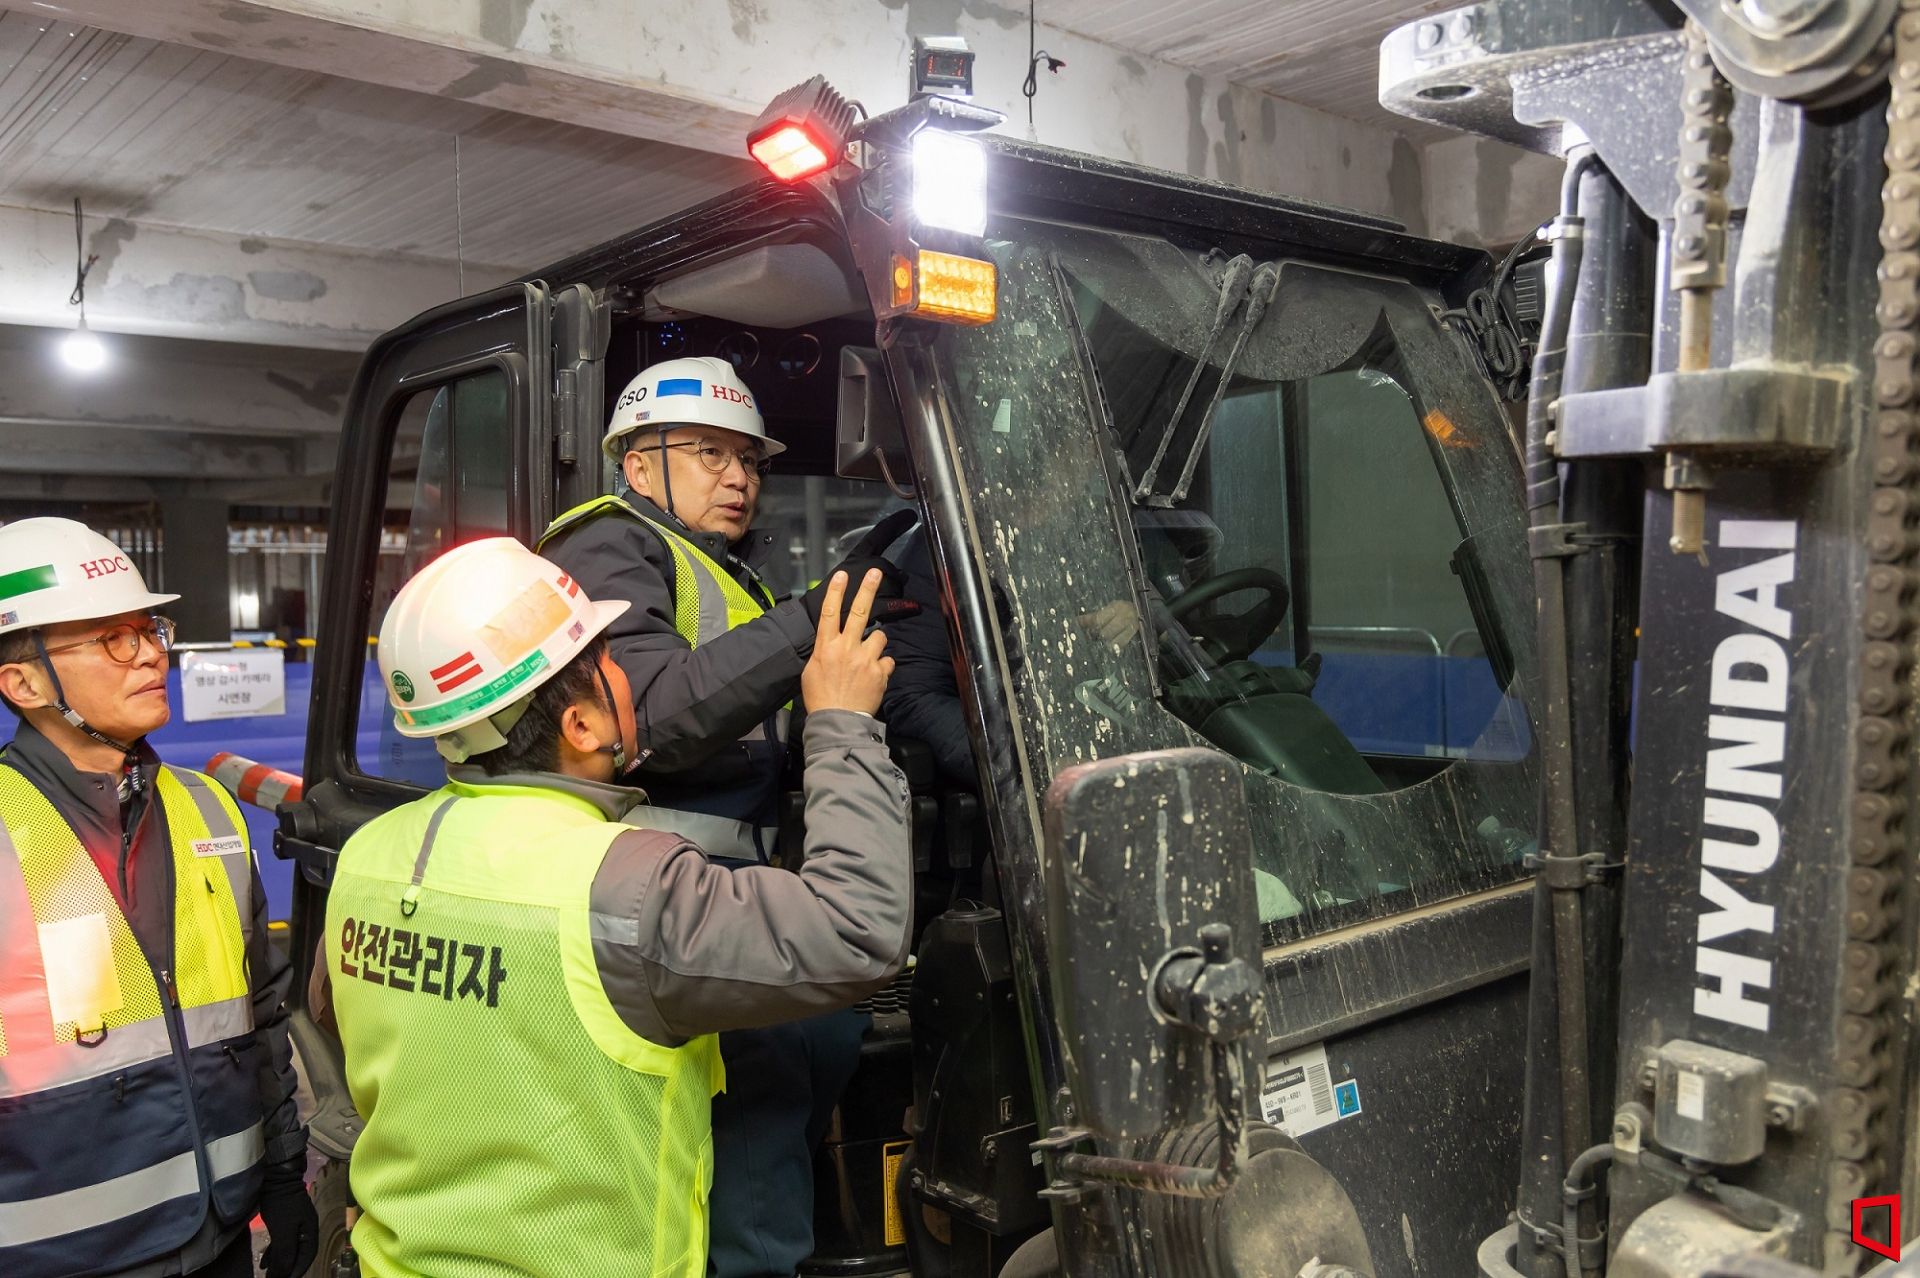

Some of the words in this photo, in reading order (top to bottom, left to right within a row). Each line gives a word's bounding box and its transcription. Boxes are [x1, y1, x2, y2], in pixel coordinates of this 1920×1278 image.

[618, 387, 648, 410] CSO
[711, 384, 752, 409] HDC
[80, 556, 129, 580] HDC
[1693, 520, 1798, 1032] HYUNDAI
[195, 842, 214, 853] HDC
[340, 916, 508, 1009] 안전관리자
